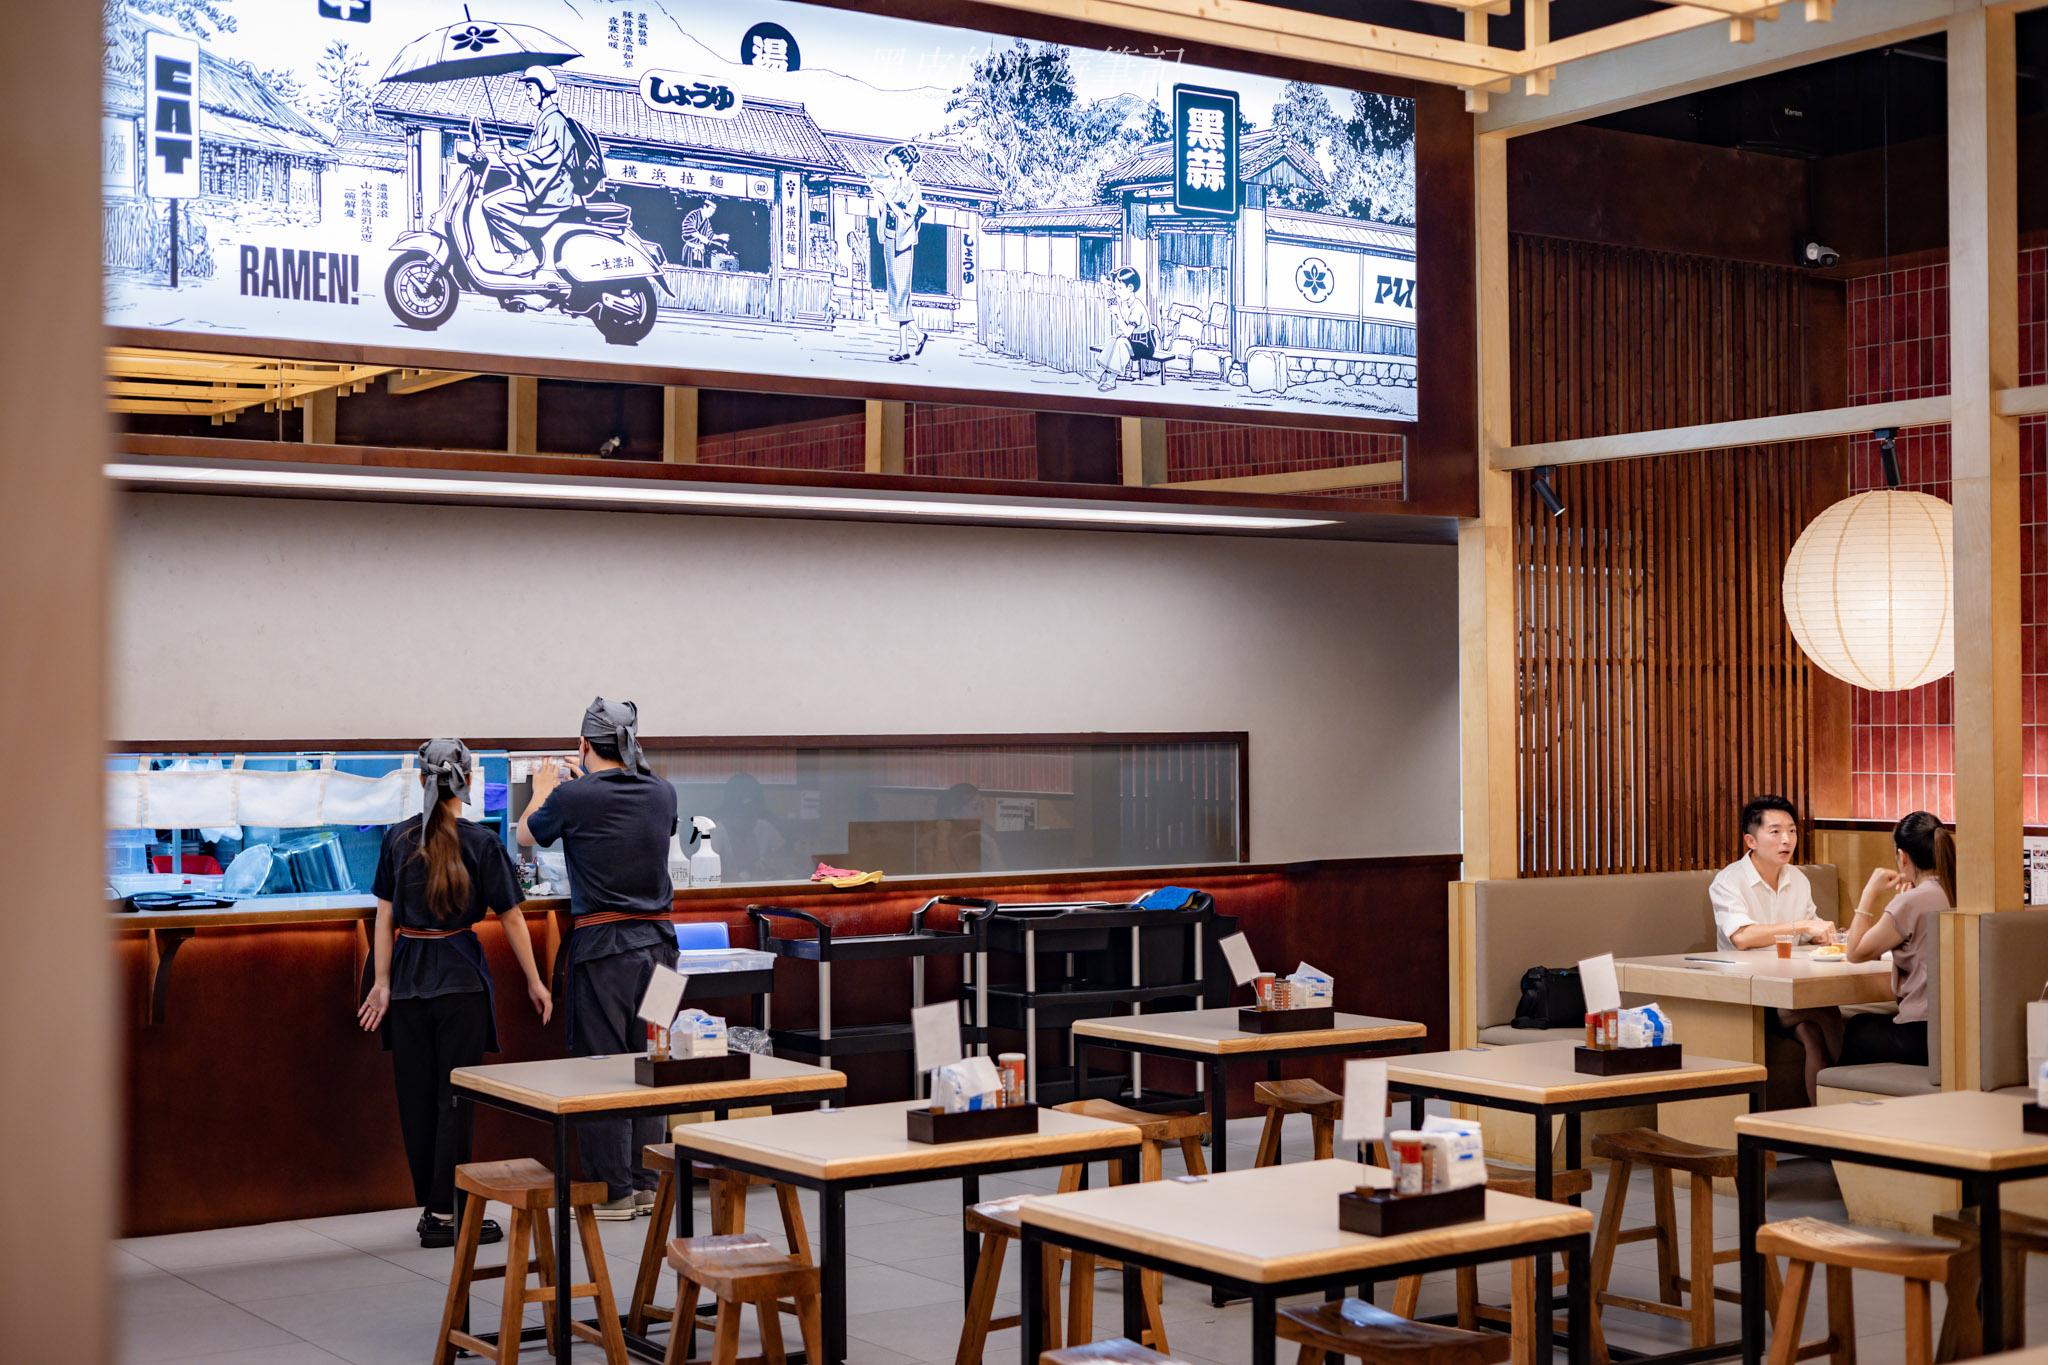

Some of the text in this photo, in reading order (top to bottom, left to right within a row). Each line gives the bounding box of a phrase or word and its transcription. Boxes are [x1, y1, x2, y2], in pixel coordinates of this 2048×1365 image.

[752, 36, 788, 72] 湯
[155, 54, 192, 174] EAT
[650, 76, 735, 112] しょうゆ
[1186, 107, 1226, 192] 黑蒜
[240, 244, 359, 305] RAMEN!
[591, 255, 635, 271] 一生漂泊
[963, 233, 975, 284] しょうゆ
[1375, 274, 1416, 309] PU
